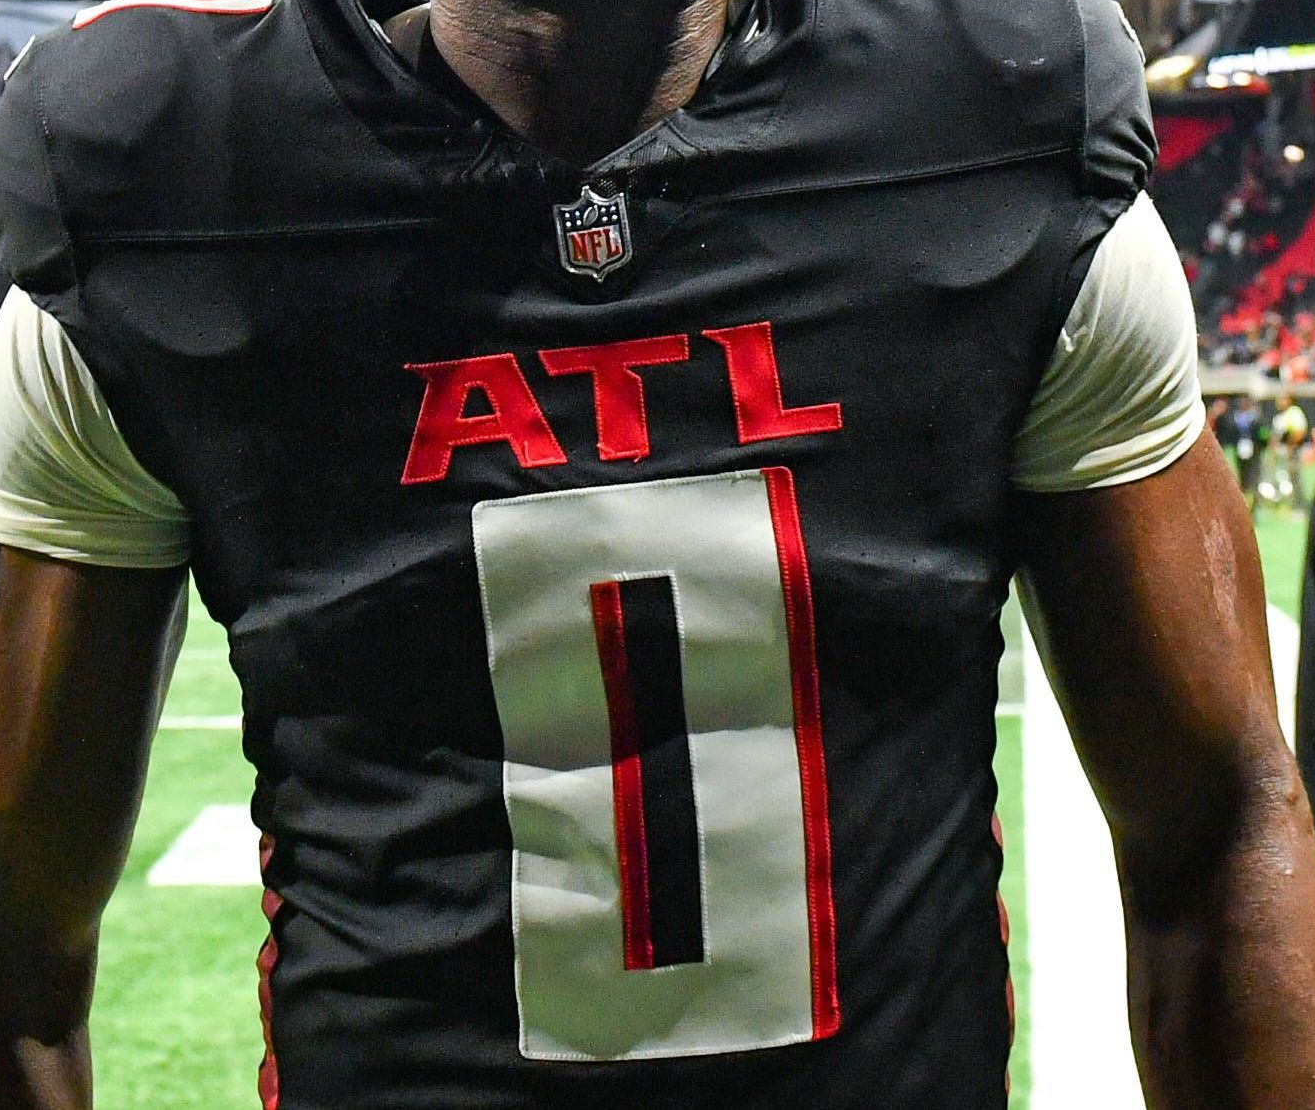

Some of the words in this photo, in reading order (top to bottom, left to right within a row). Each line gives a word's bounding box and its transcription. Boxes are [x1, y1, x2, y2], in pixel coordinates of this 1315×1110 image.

[568, 227, 622, 265] NFL
[400, 320, 843, 485] ATL
[471, 466, 842, 1062] 0
